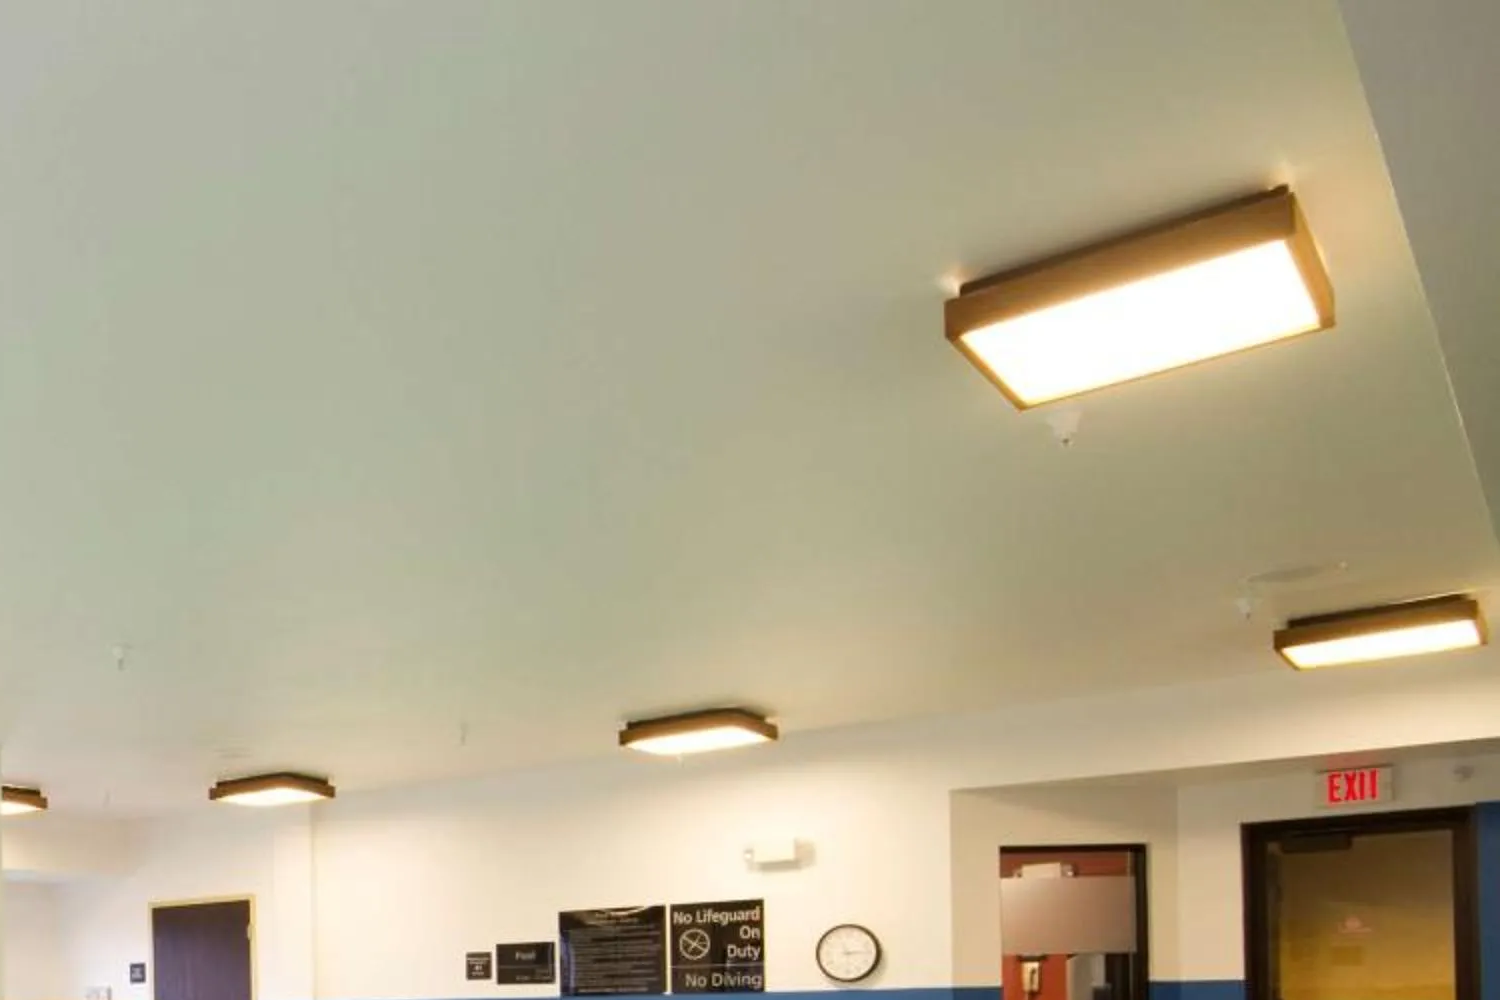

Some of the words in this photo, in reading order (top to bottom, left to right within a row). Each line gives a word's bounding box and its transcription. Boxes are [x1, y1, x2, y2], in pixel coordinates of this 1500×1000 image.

[1327, 768, 1378, 803] EXIT
[673, 911, 693, 925] No
[695, 906, 761, 927] Lifeguard
[739, 925, 761, 939] On
[727, 944, 761, 960] Duty
[685, 973, 707, 987] No
[711, 971, 762, 989] Diving
